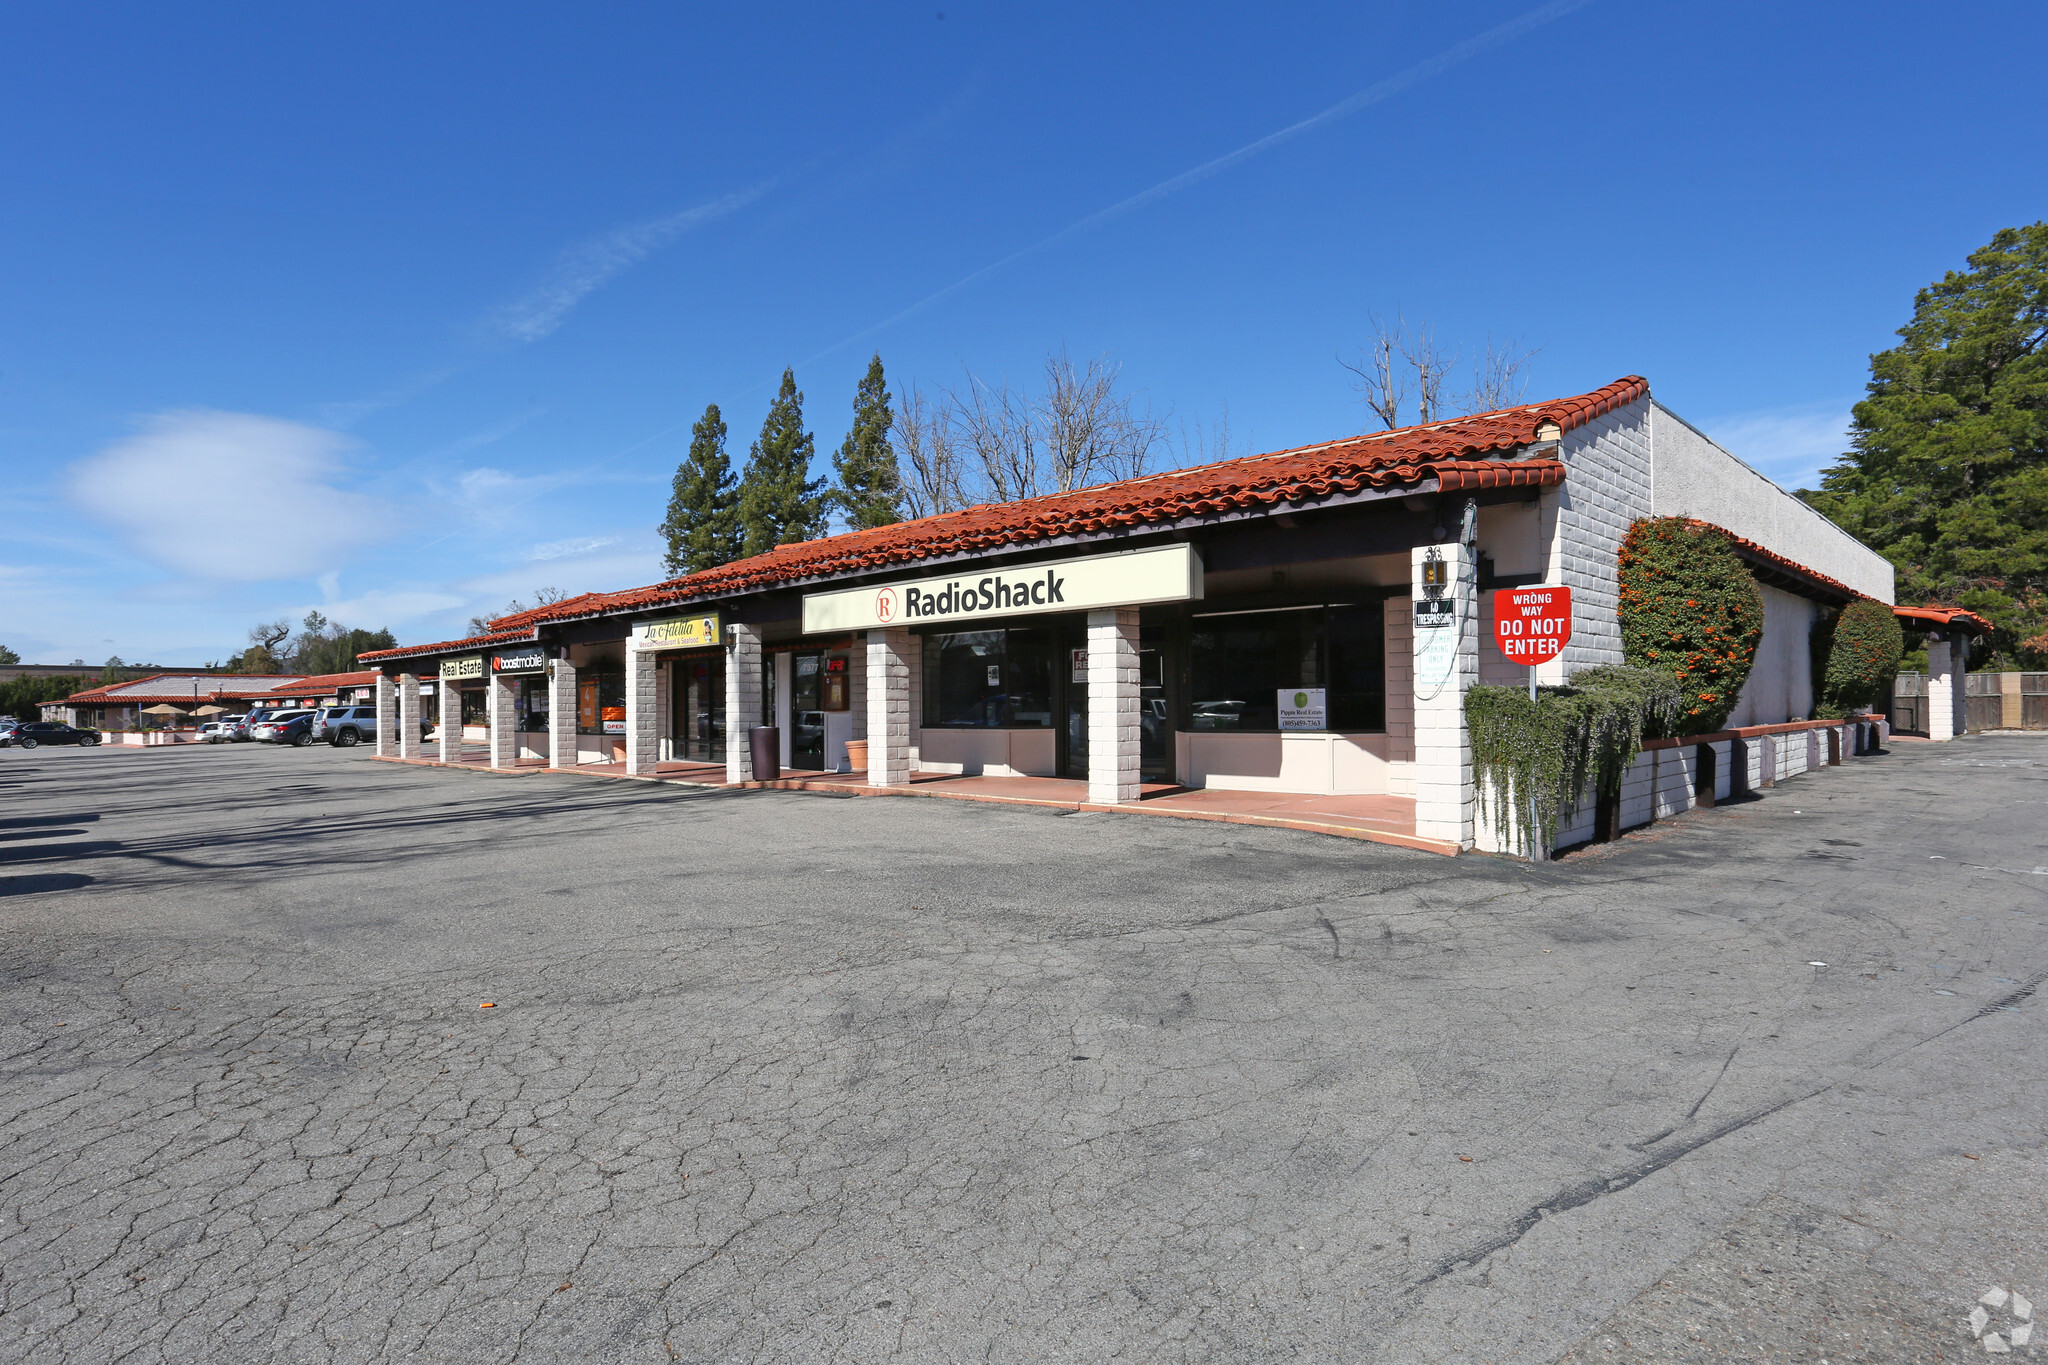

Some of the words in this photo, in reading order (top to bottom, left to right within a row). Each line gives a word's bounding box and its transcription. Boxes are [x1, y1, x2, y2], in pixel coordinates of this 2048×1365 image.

[906, 569, 1065, 617] RadioShack
[1513, 594, 1552, 605] WRONG
[1431, 602, 1439, 613] NO
[1521, 606, 1543, 616] WAY
[1417, 613, 1453, 625] TRESPASSING
[645, 623, 656, 641] La
[658, 619, 694, 641] Adelita
[1500, 619, 1523, 636] DO
[1531, 618, 1565, 635] NOT
[654, 638, 677, 647] Restaurant
[681, 636, 699, 645] Seafood
[1505, 638, 1559, 655] ENTER
[1423, 645, 1449, 653] ARKING
[500, 654, 543, 670] boostmobile
[1429, 655, 1444, 664] ONLY
[442, 661, 457, 677] Real
[459, 660, 482, 676] Estate
